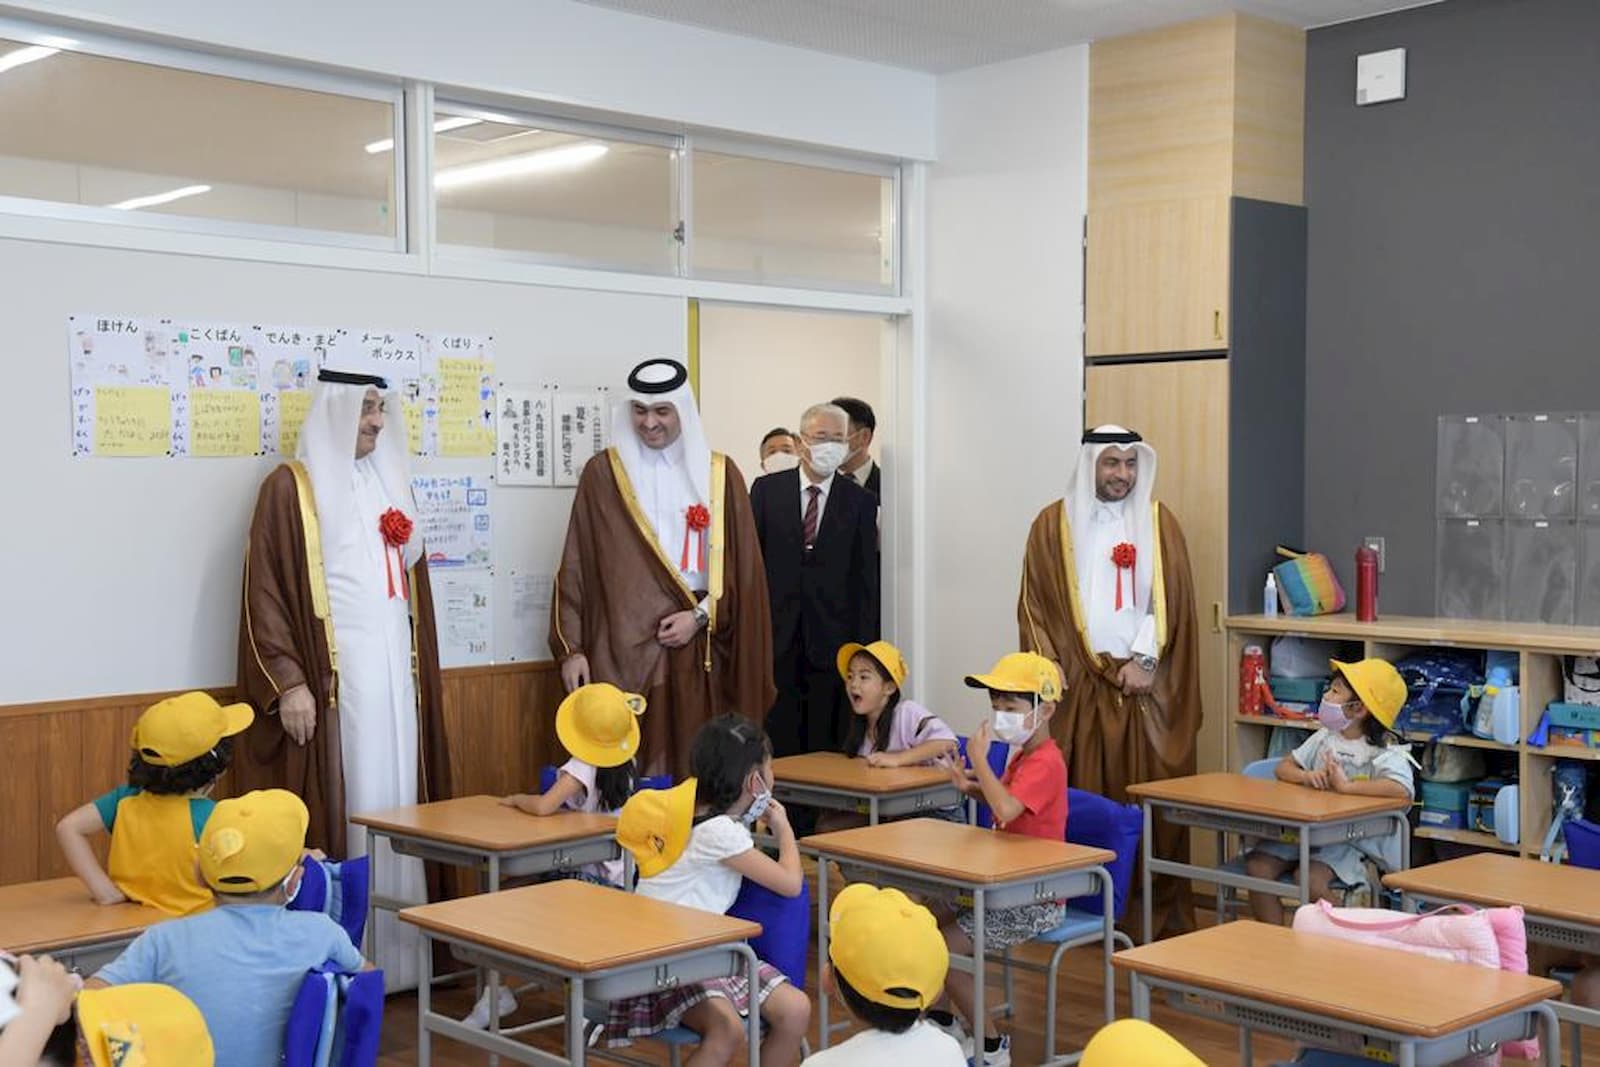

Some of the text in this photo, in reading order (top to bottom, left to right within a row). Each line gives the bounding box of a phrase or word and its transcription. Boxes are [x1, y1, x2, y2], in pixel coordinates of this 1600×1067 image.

[97, 319, 138, 333] ほけん
[190, 327, 241, 343] こくばん
[362, 333, 394, 345] メール
[442, 337, 472, 350] くばり
